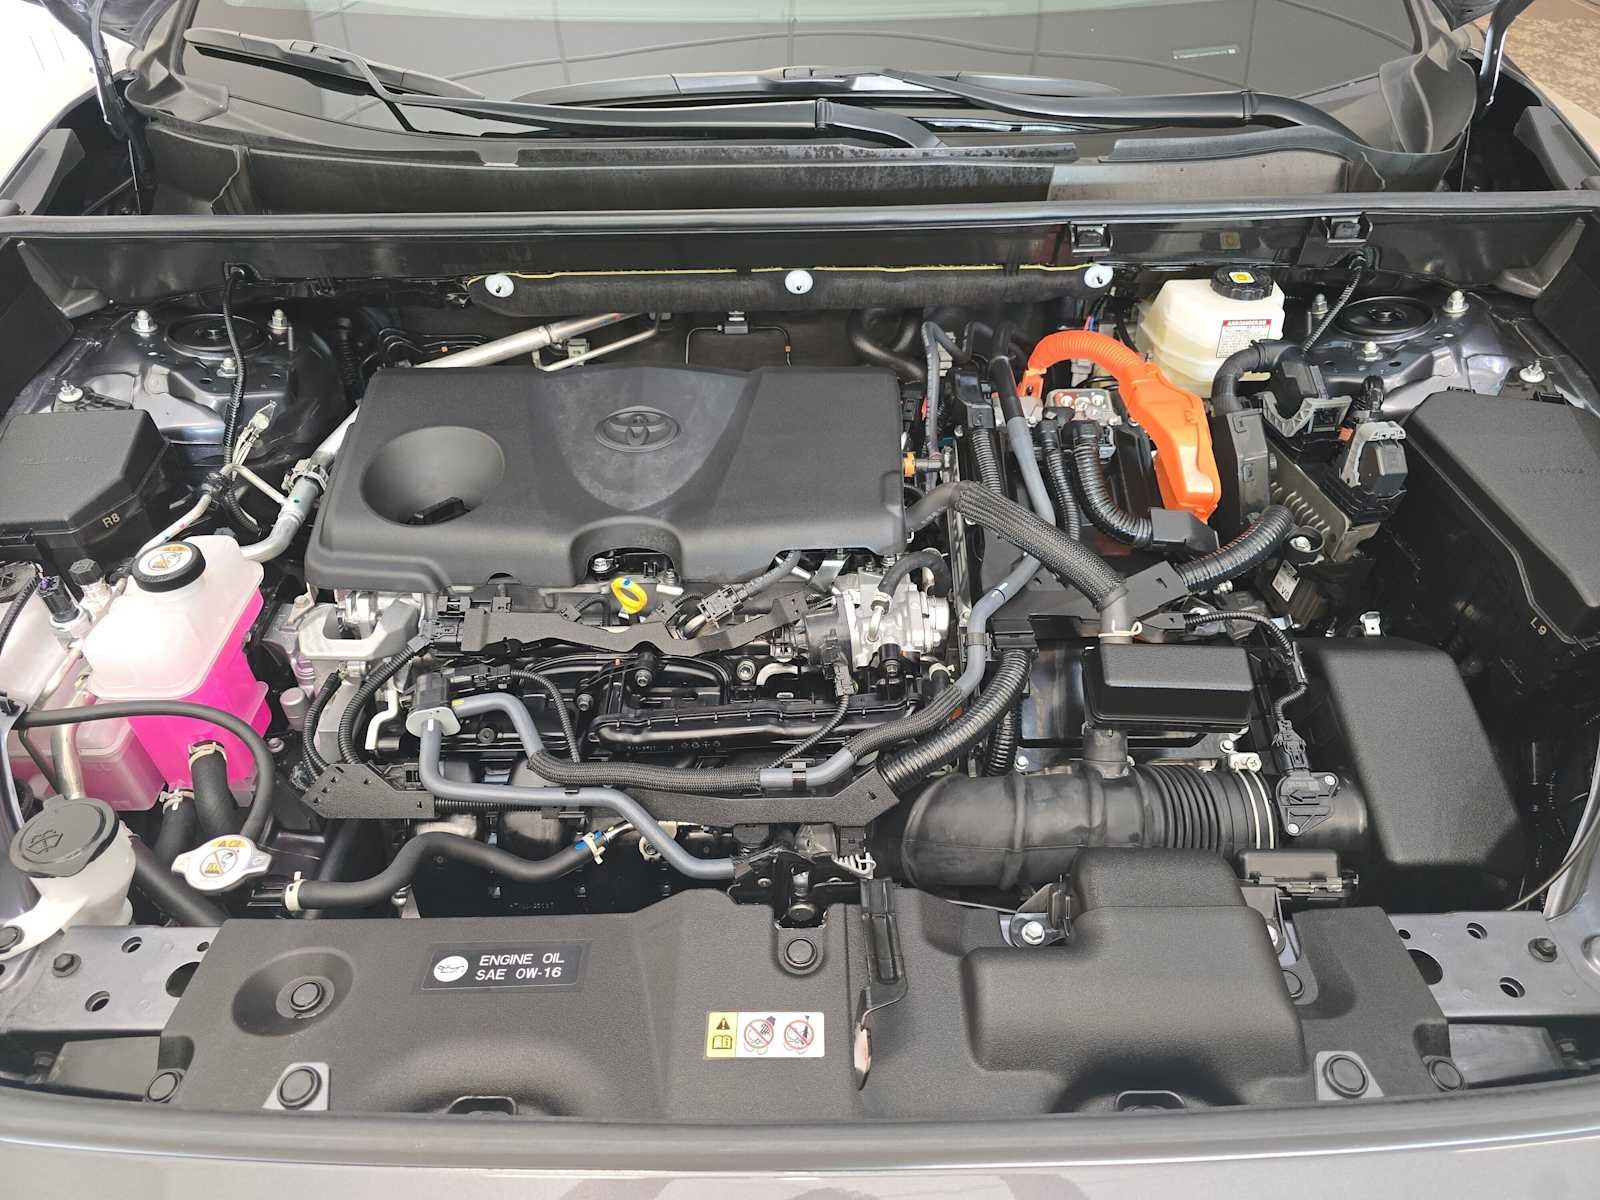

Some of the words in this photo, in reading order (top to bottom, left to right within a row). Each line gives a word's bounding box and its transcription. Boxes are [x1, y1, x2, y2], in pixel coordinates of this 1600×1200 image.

[102, 513, 120, 528] R8
[1530, 617, 1547, 635] L9
[479, 953, 533, 966] ENGINE
[542, 952, 565, 964] OIL
[475, 968, 507, 981] SAE
